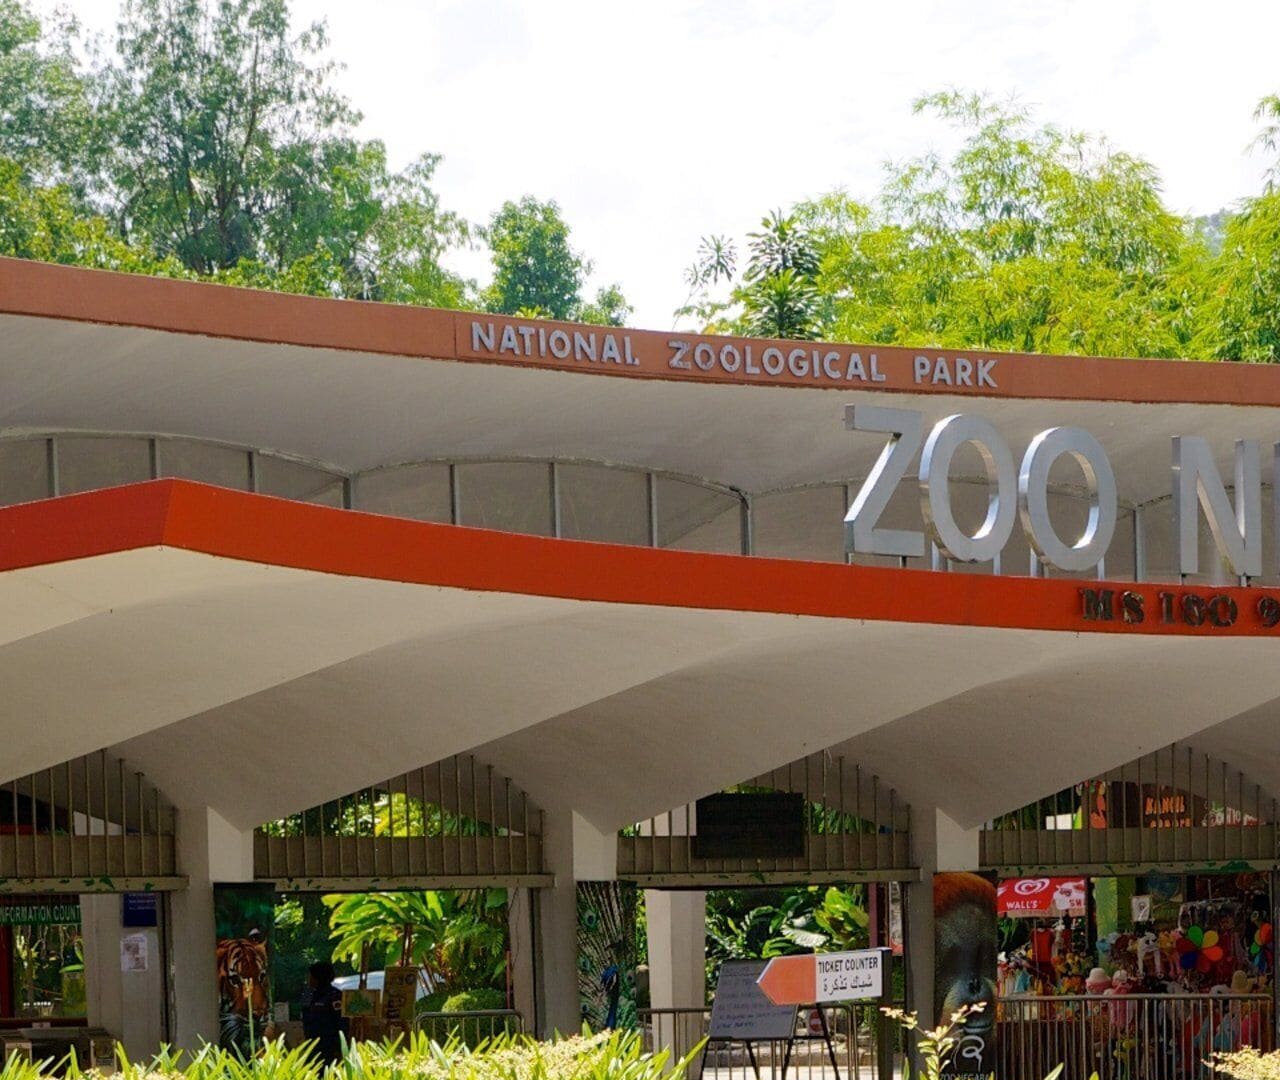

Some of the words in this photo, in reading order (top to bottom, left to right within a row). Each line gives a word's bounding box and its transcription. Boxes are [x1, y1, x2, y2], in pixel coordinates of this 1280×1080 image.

[471, 322, 640, 366] NATIONAL
[668, 340, 886, 382] ZOOLOGICAL
[913, 355, 998, 387] PARK
[844, 404, 1117, 572] ZOO
[1079, 588, 1146, 624] MS
[1159, 592, 1238, 627] ISO
[1006, 900, 1038, 909] WALL'S
[818, 959, 843, 973] TICKET
[845, 957, 878, 971] COUNTER
